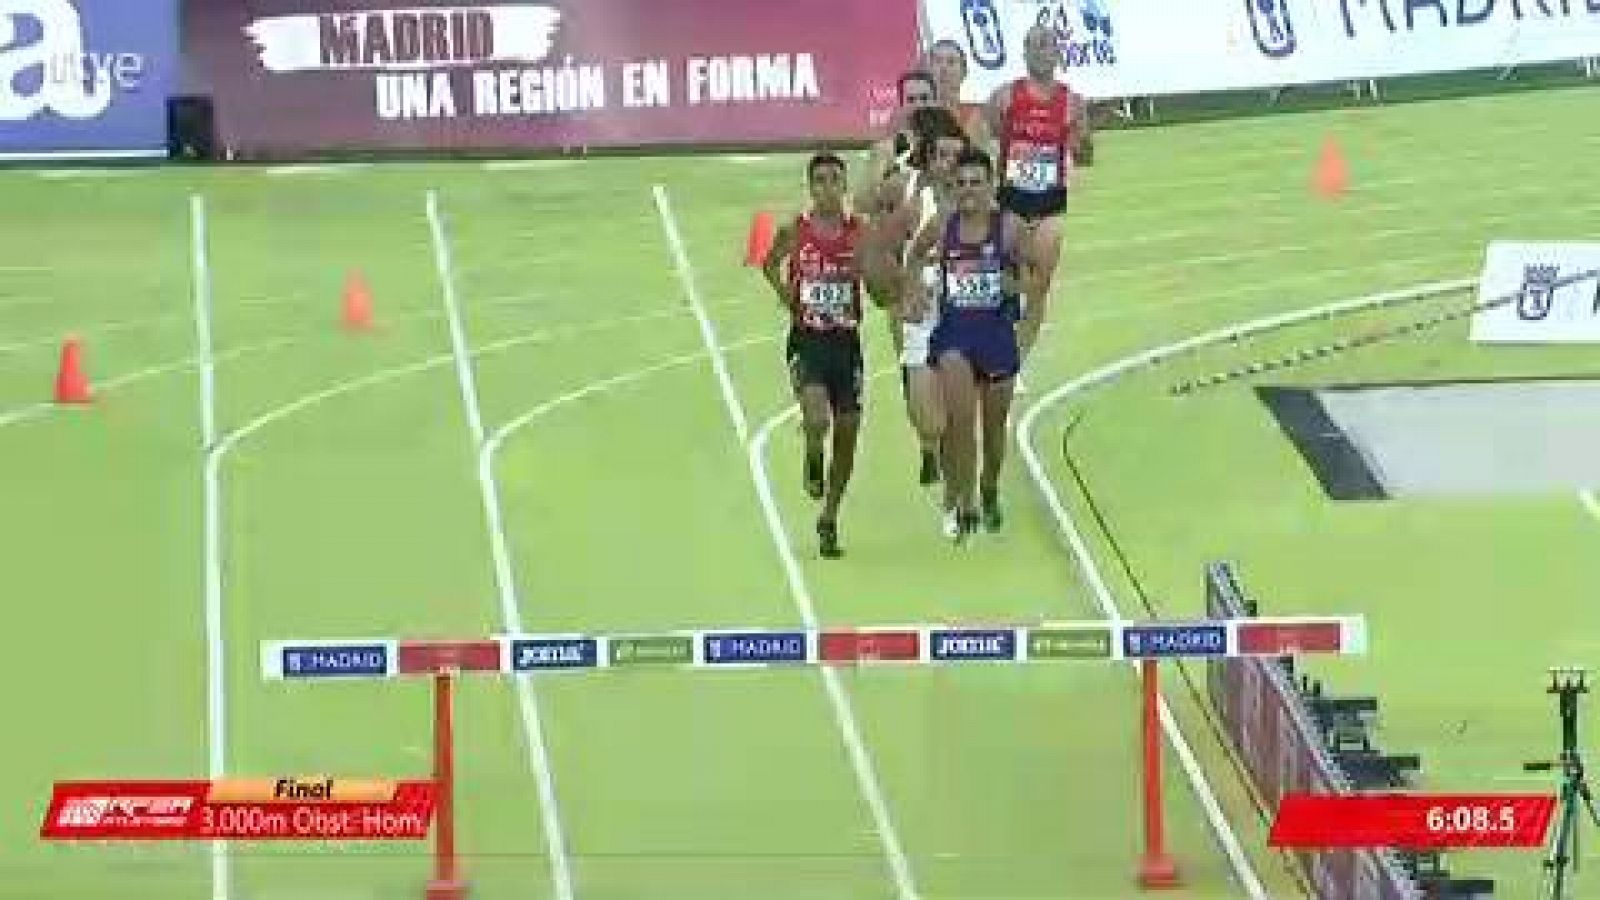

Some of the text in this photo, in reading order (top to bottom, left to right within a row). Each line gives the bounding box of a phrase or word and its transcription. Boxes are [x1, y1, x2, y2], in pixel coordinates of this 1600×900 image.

[319, 11, 494, 63] MADRID
[376, 72, 454, 117] UNA
[473, 56, 604, 114] REGIÓN
[622, 61, 669, 106] EN
[687, 52, 819, 103] FORMA
[732, 638, 801, 655] MADRID
[1152, 630, 1221, 650] MADRID
[312, 652, 381, 668] MADRID
